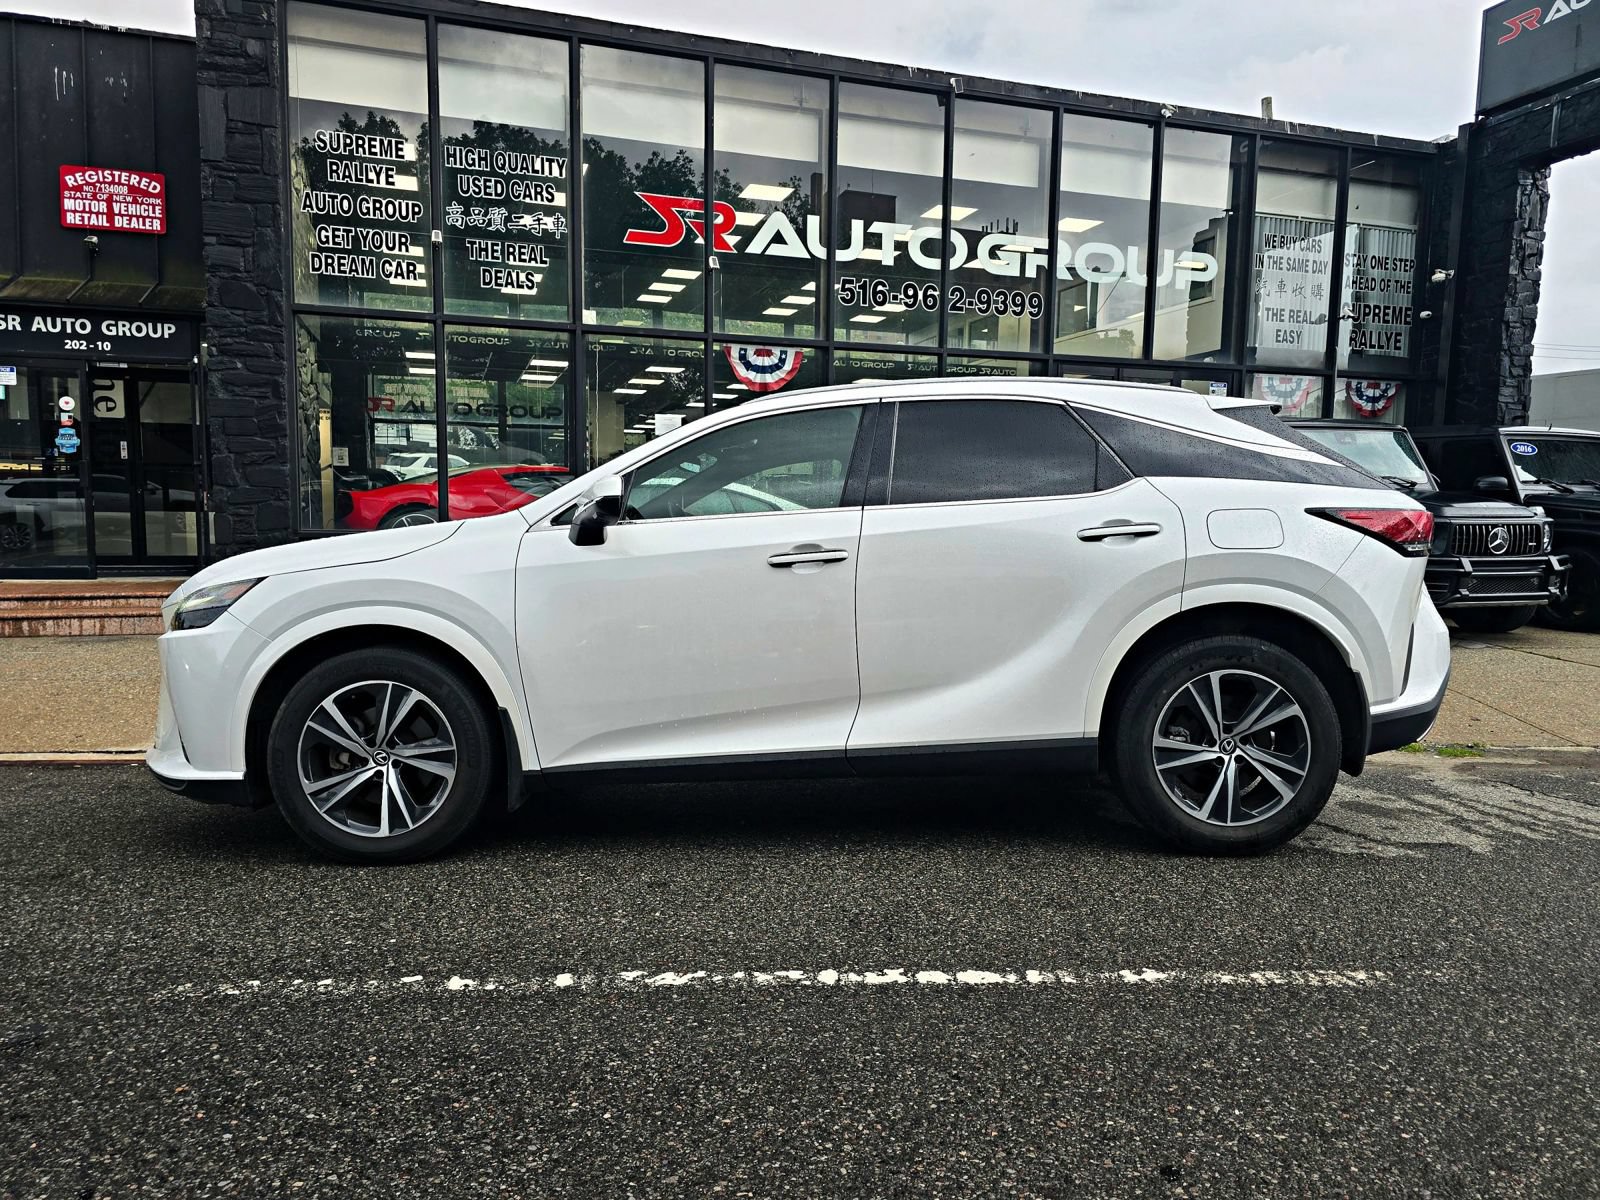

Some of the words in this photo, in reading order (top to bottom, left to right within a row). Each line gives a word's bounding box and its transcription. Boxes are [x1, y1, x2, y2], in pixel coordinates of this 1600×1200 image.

[315, 129, 405, 160] SUPREME
[327, 159, 396, 187] RALLYE
[444, 145, 490, 171] HIGH
[494, 151, 567, 178] QUALITY
[65, 170, 161, 194] REGISTERED
[458, 174, 506, 200] USED
[509, 180, 556, 204] CARS
[64, 191, 93, 200] STATE
[137, 197, 162, 205] YORK
[64, 199, 107, 213] MOTOR
[113, 202, 162, 218] VEHICLE
[301, 191, 353, 216] AUTO
[357, 195, 423, 223] GROUP
[66, 212, 110, 227] RETAIL
[114, 216, 161, 231] DEALER
[446, 201, 568, 239] 高品質二手車
[316, 224, 354, 249] GET
[357, 228, 411, 253] YOUR
[1264, 232, 1277, 249] WE
[1279, 235, 1297, 250] BUY
[1300, 237, 1322, 254] CARS
[466, 239, 502, 262] THE
[505, 242, 549, 267] REAL
[744, 211, 968, 271] AUTO
[977, 233, 1218, 290] GROUP
[309, 252, 376, 279] DREAM
[380, 258, 419, 281] CAR
[1255, 253, 1264, 269] IN
[1267, 254, 1284, 271] THE
[1286, 256, 1310, 274] SAME
[1311, 259, 1328, 275] DAY
[1344, 253, 1368, 269] STAY
[1370, 255, 1389, 271] ONE
[1392, 257, 1416, 273] STEP
[480, 267, 537, 291] DEALS
[1345, 275, 1376, 292] AHEAD
[1379, 277, 1391, 293] OF
[1393, 278, 1412, 294] THE
[31, 316, 92, 334] AUTO
[101, 320, 176, 338] GROUP
[1265, 307, 1285, 323] THE
[1288, 309, 1314, 325] REAL
[1275, 329, 1302, 345] EASY
[1350, 329, 1402, 351] RALLYE
[1516, 444, 1533, 453] 2016
